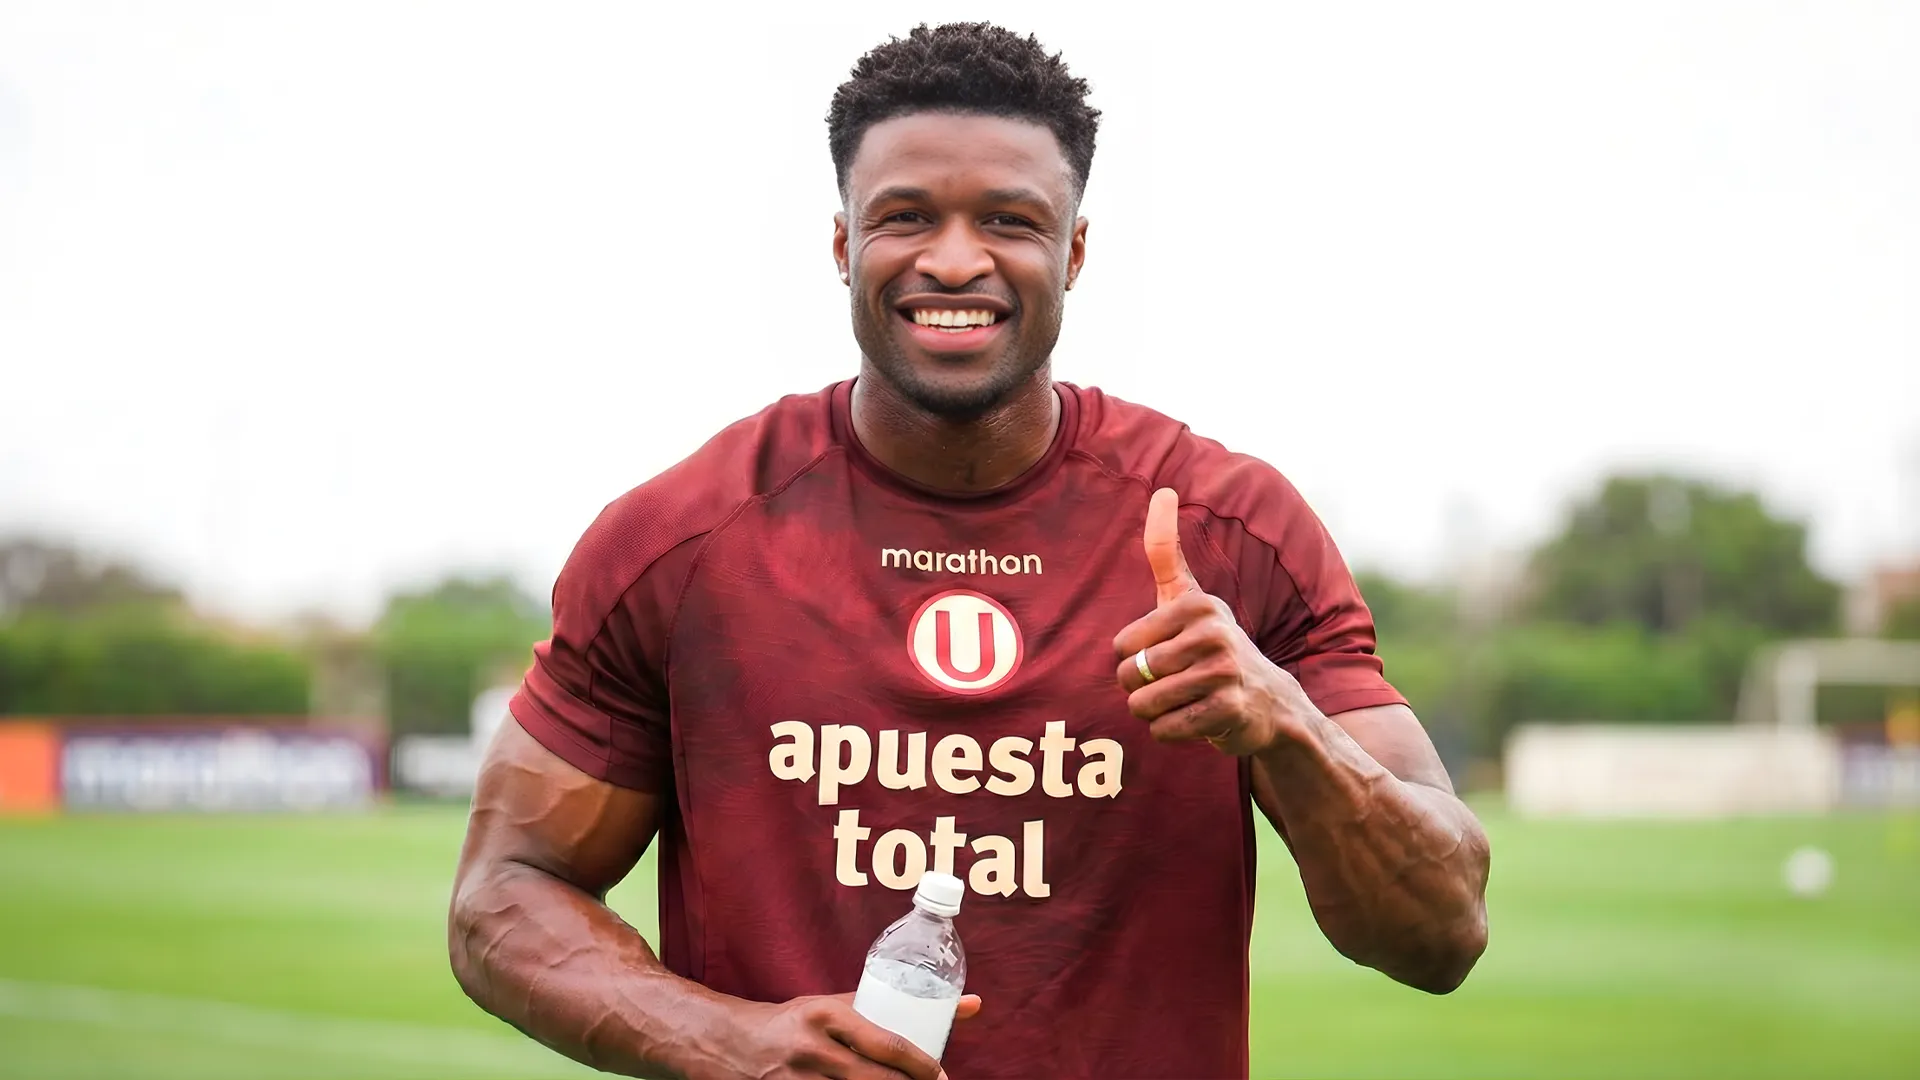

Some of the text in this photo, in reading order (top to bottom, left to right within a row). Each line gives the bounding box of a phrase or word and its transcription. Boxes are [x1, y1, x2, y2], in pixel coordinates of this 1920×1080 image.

[881, 548, 1043, 575] marathon
[935, 610, 996, 682] U
[768, 720, 1124, 806] apuesta
[833, 809, 1051, 898] total
